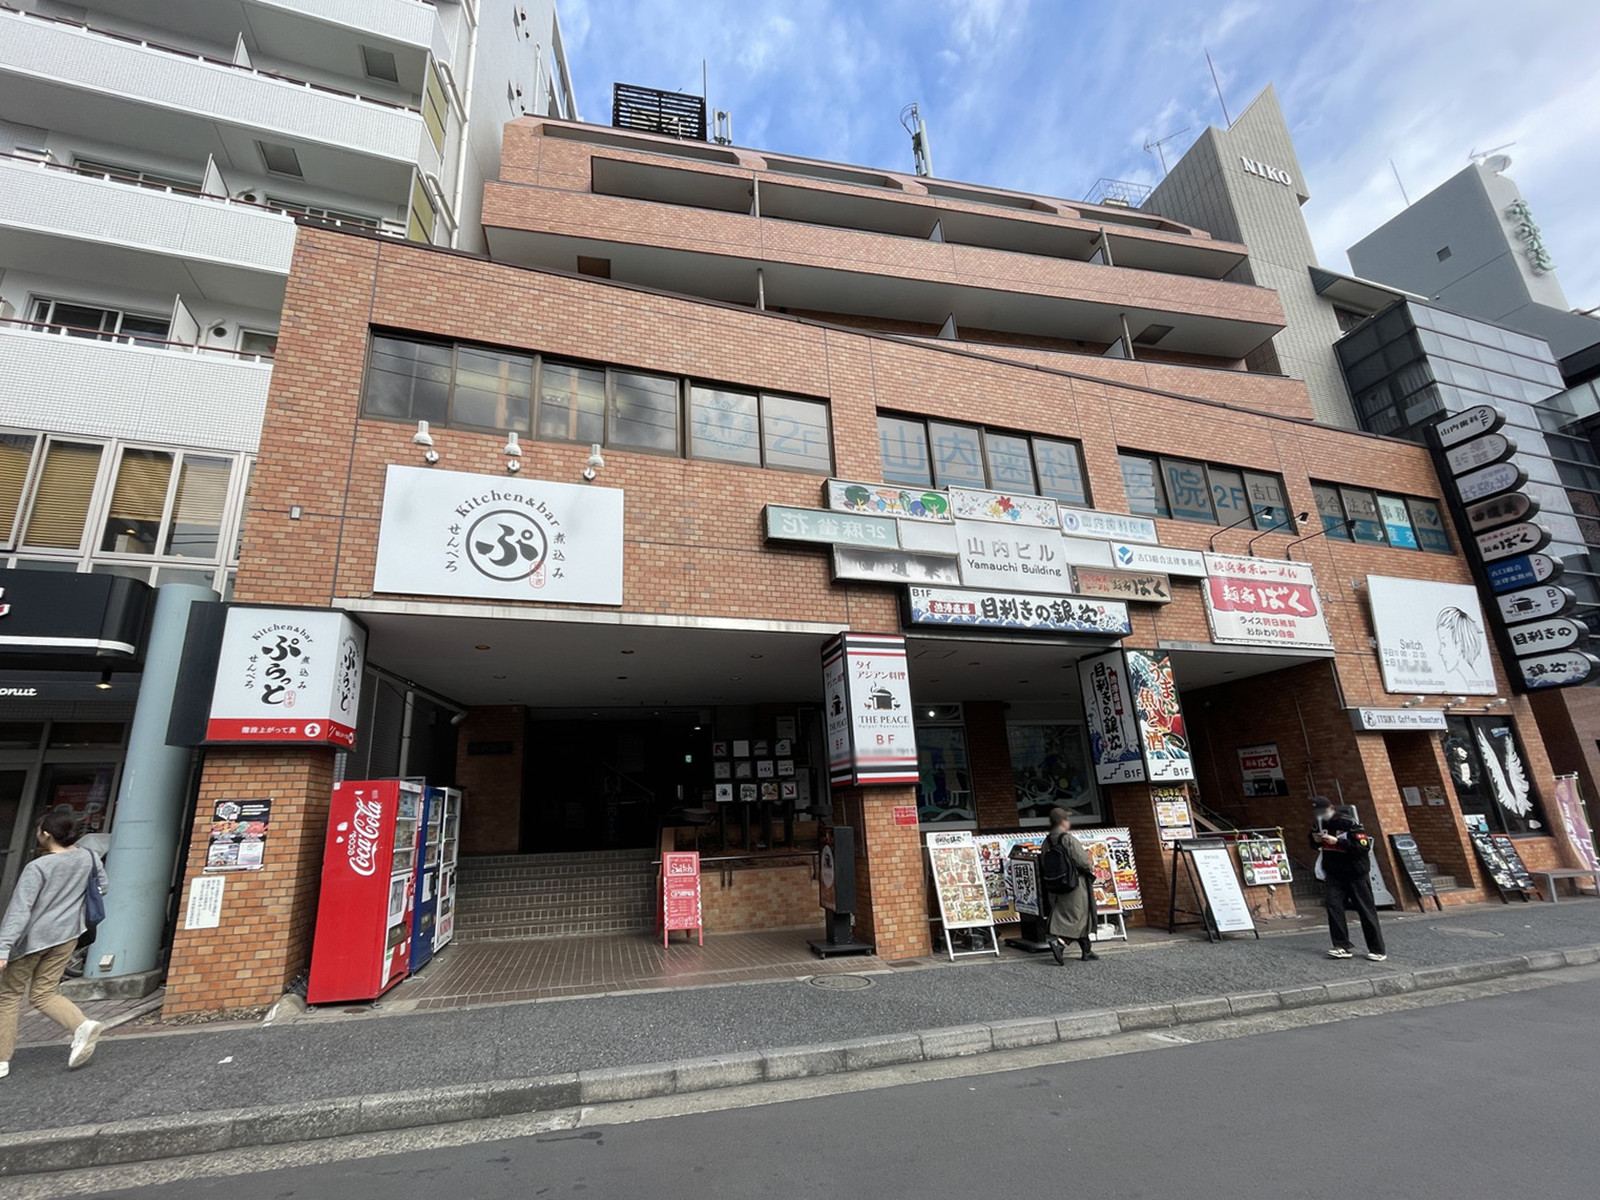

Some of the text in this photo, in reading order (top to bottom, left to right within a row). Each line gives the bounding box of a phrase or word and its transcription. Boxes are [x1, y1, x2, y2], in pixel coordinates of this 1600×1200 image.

[1240, 156, 1292, 187] NIKO
[772, 415, 821, 454] 2F
[881, 428, 1081, 489] 山内歯科
[454, 489, 561, 528] Kitchen&bar
[1213, 485, 1244, 510] 2F
[444, 522, 462, 573] せんべろ
[552, 531, 567, 580] 煮込み
[966, 537, 1055, 563] 山内ビル
[966, 559, 1018, 573] Yamauchi
[1022, 561, 1062, 577] Building
[912, 588, 932, 599] B1F
[981, 597, 1099, 627] 目利きの銀次
[251, 623, 314, 644] Kitchen&bar
[1399, 638, 1423, 651] Switch
[261, 635, 302, 705] ぷらっと
[297, 656, 310, 690] 煮込み
[856, 671, 906, 681] アジアン料理
[858, 716, 909, 724] THE PEACE
[1139, 687, 1166, 751] 魚と酒
[1376, 714, 1397, 724] ITSUKI
[1398, 714, 1418, 724] Coffee
[1124, 769, 1142, 780] B1F
[1173, 767, 1190, 777] B1F
